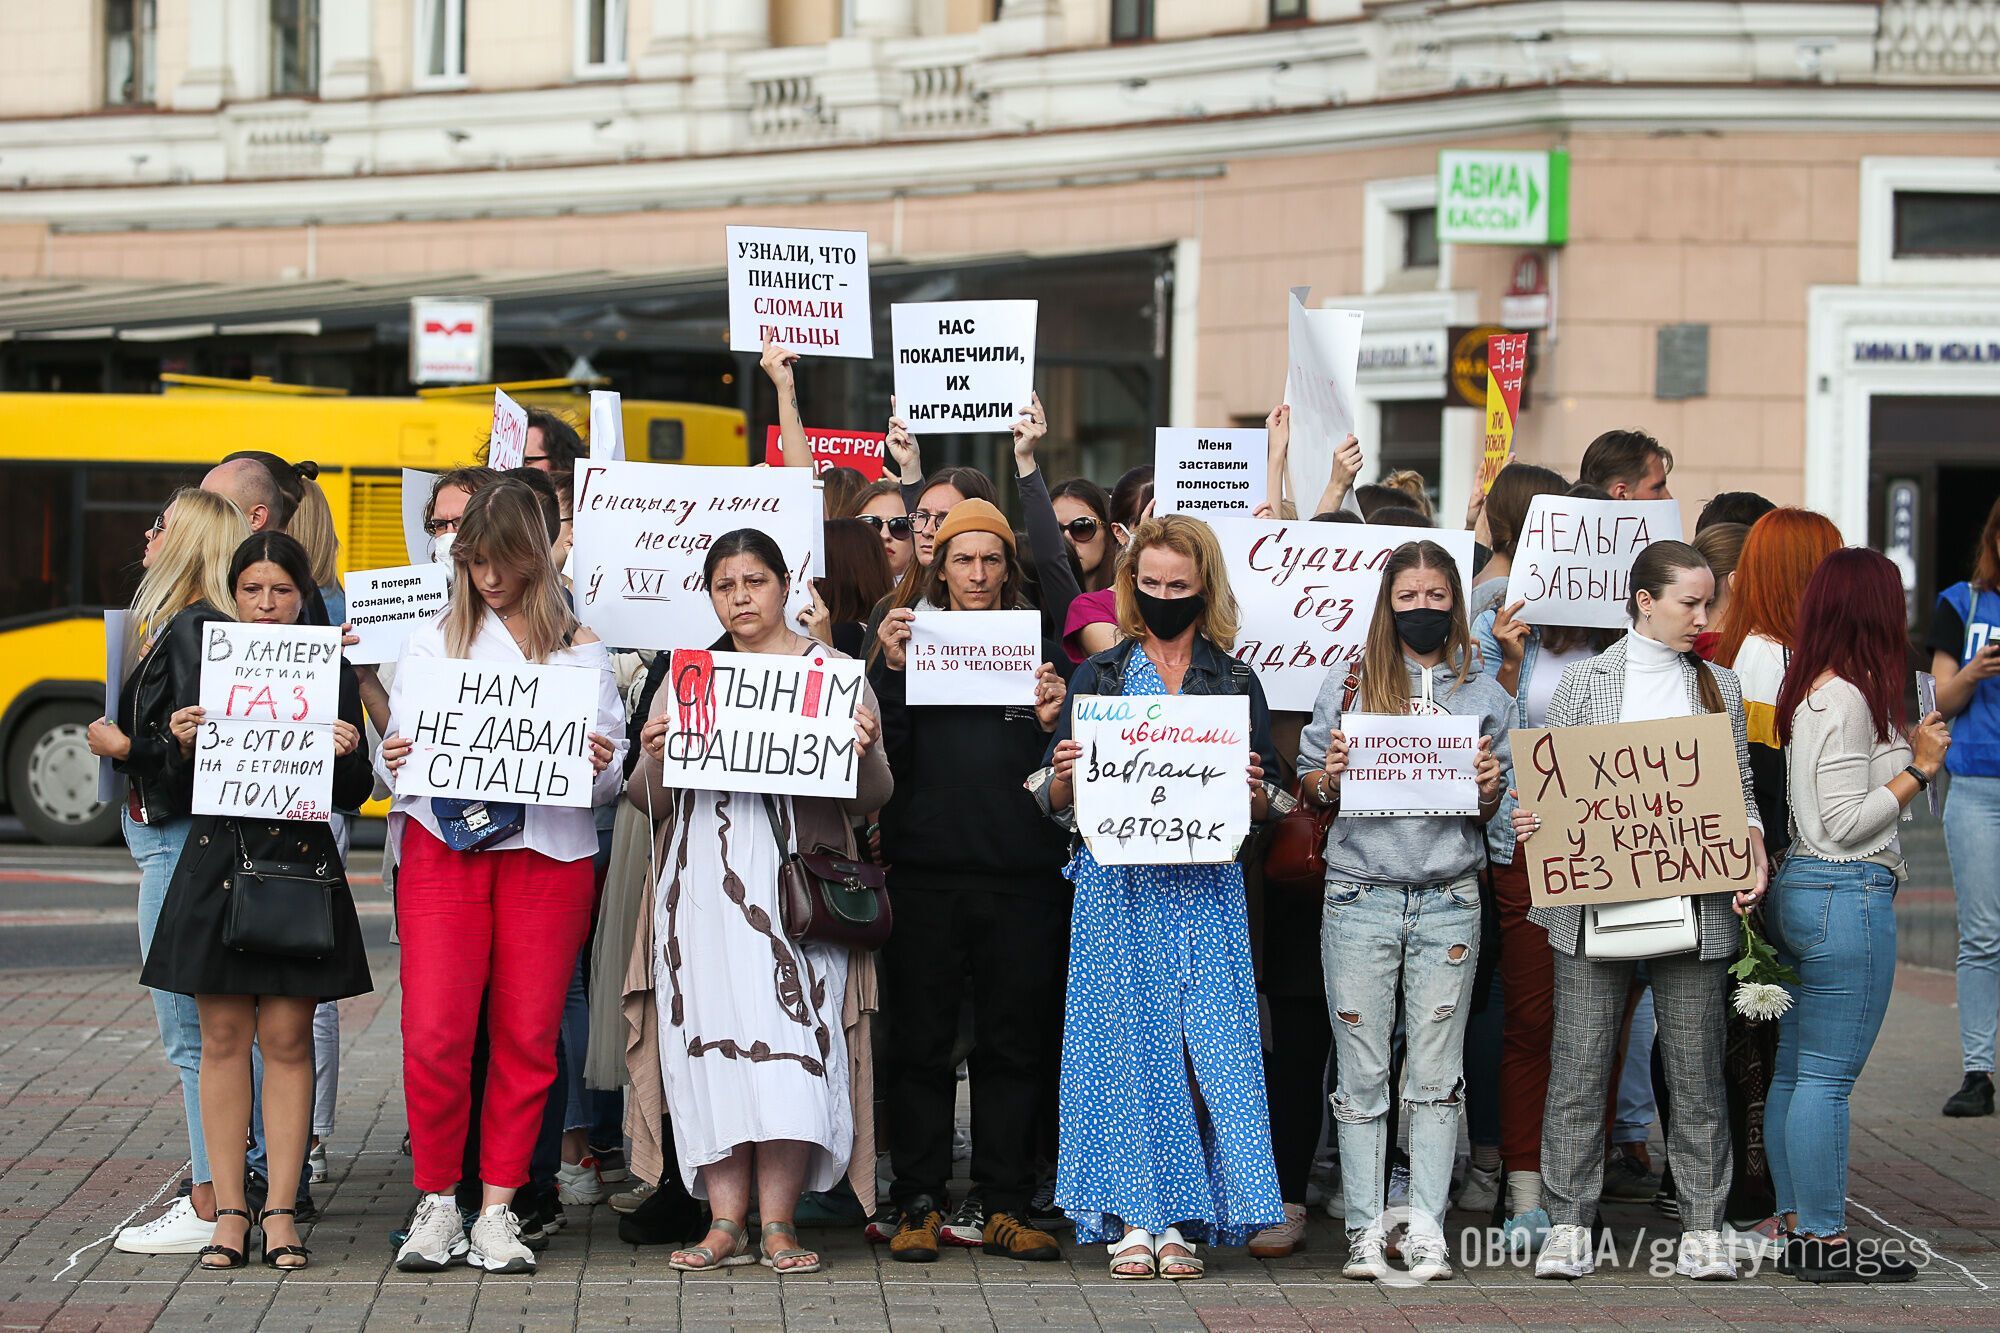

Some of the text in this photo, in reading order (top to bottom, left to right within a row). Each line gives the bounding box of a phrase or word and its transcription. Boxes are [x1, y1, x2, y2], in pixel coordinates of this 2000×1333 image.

[1451, 163, 1521, 198] АВИА
[1447, 206, 1520, 229] КАССЫ
[737, 242, 856, 265] УЗНАЛИ, ЧТО
[748, 269, 834, 291] ПИАНИСТ
[754, 297, 843, 319] СЛОМАЛИ
[759, 324, 840, 349] ПАЛЬЦЫ
[938, 319, 975, 336] НАС
[900, 346, 1025, 365] ПОКАЛЕЧИЛИ,
[946, 375, 971, 391] ИХ
[909, 402, 1014, 421] НАГРАДИЛИ
[1197, 439, 1232, 450] Меня
[1178, 459, 1248, 470] заставили
[1176, 479, 1250, 491] полностью
[577, 467, 780, 526] Генацыду няма
[1176, 499, 1249, 511] раздеться.
[1526, 510, 1651, 556] НЕЛЬГА
[1248, 527, 1393, 587] Судил
[371, 577, 421, 590] Я потерял
[351, 591, 442, 609] сознание, а меня
[1293, 585, 1354, 632] без
[350, 608, 439, 626] продолжали бит
[207, 627, 337, 664] В КАМЕРУ
[915, 644, 1035, 657] 1,5 ЛИТРА ВОДЫ
[1235, 639, 1367, 672] адвок
[916, 660, 1033, 671] НА 30 ЧЕЛОВЕК
[458, 672, 539, 709] НАМ
[225, 684, 309, 721] ГАЗ
[243, 729, 314, 752] СУТОК
[414, 710, 588, 757] НЕ ДАВАЛІ
[1121, 721, 1241, 746] цветами
[1349, 737, 1473, 749] Я ПРОСТО ШЕЛ
[667, 728, 856, 782] ФАШЫЗМ
[1375, 751, 1442, 765] ДОМОЙ.
[199, 758, 324, 776] НА БЕТОННОМ
[428, 753, 569, 803] СПАЦЬ
[1347, 768, 1407, 781] ТЕПЕРЬ
[1411, 768, 1422, 781] Я
[1532, 732, 1568, 802] Я
[218, 780, 300, 815] ПОЛУ
[296, 800, 316, 810] БЕЗ
[286, 810, 329, 820] ОДЕЖДЫ
[1542, 837, 1751, 895] БЕЗ ГВАЛТУ
